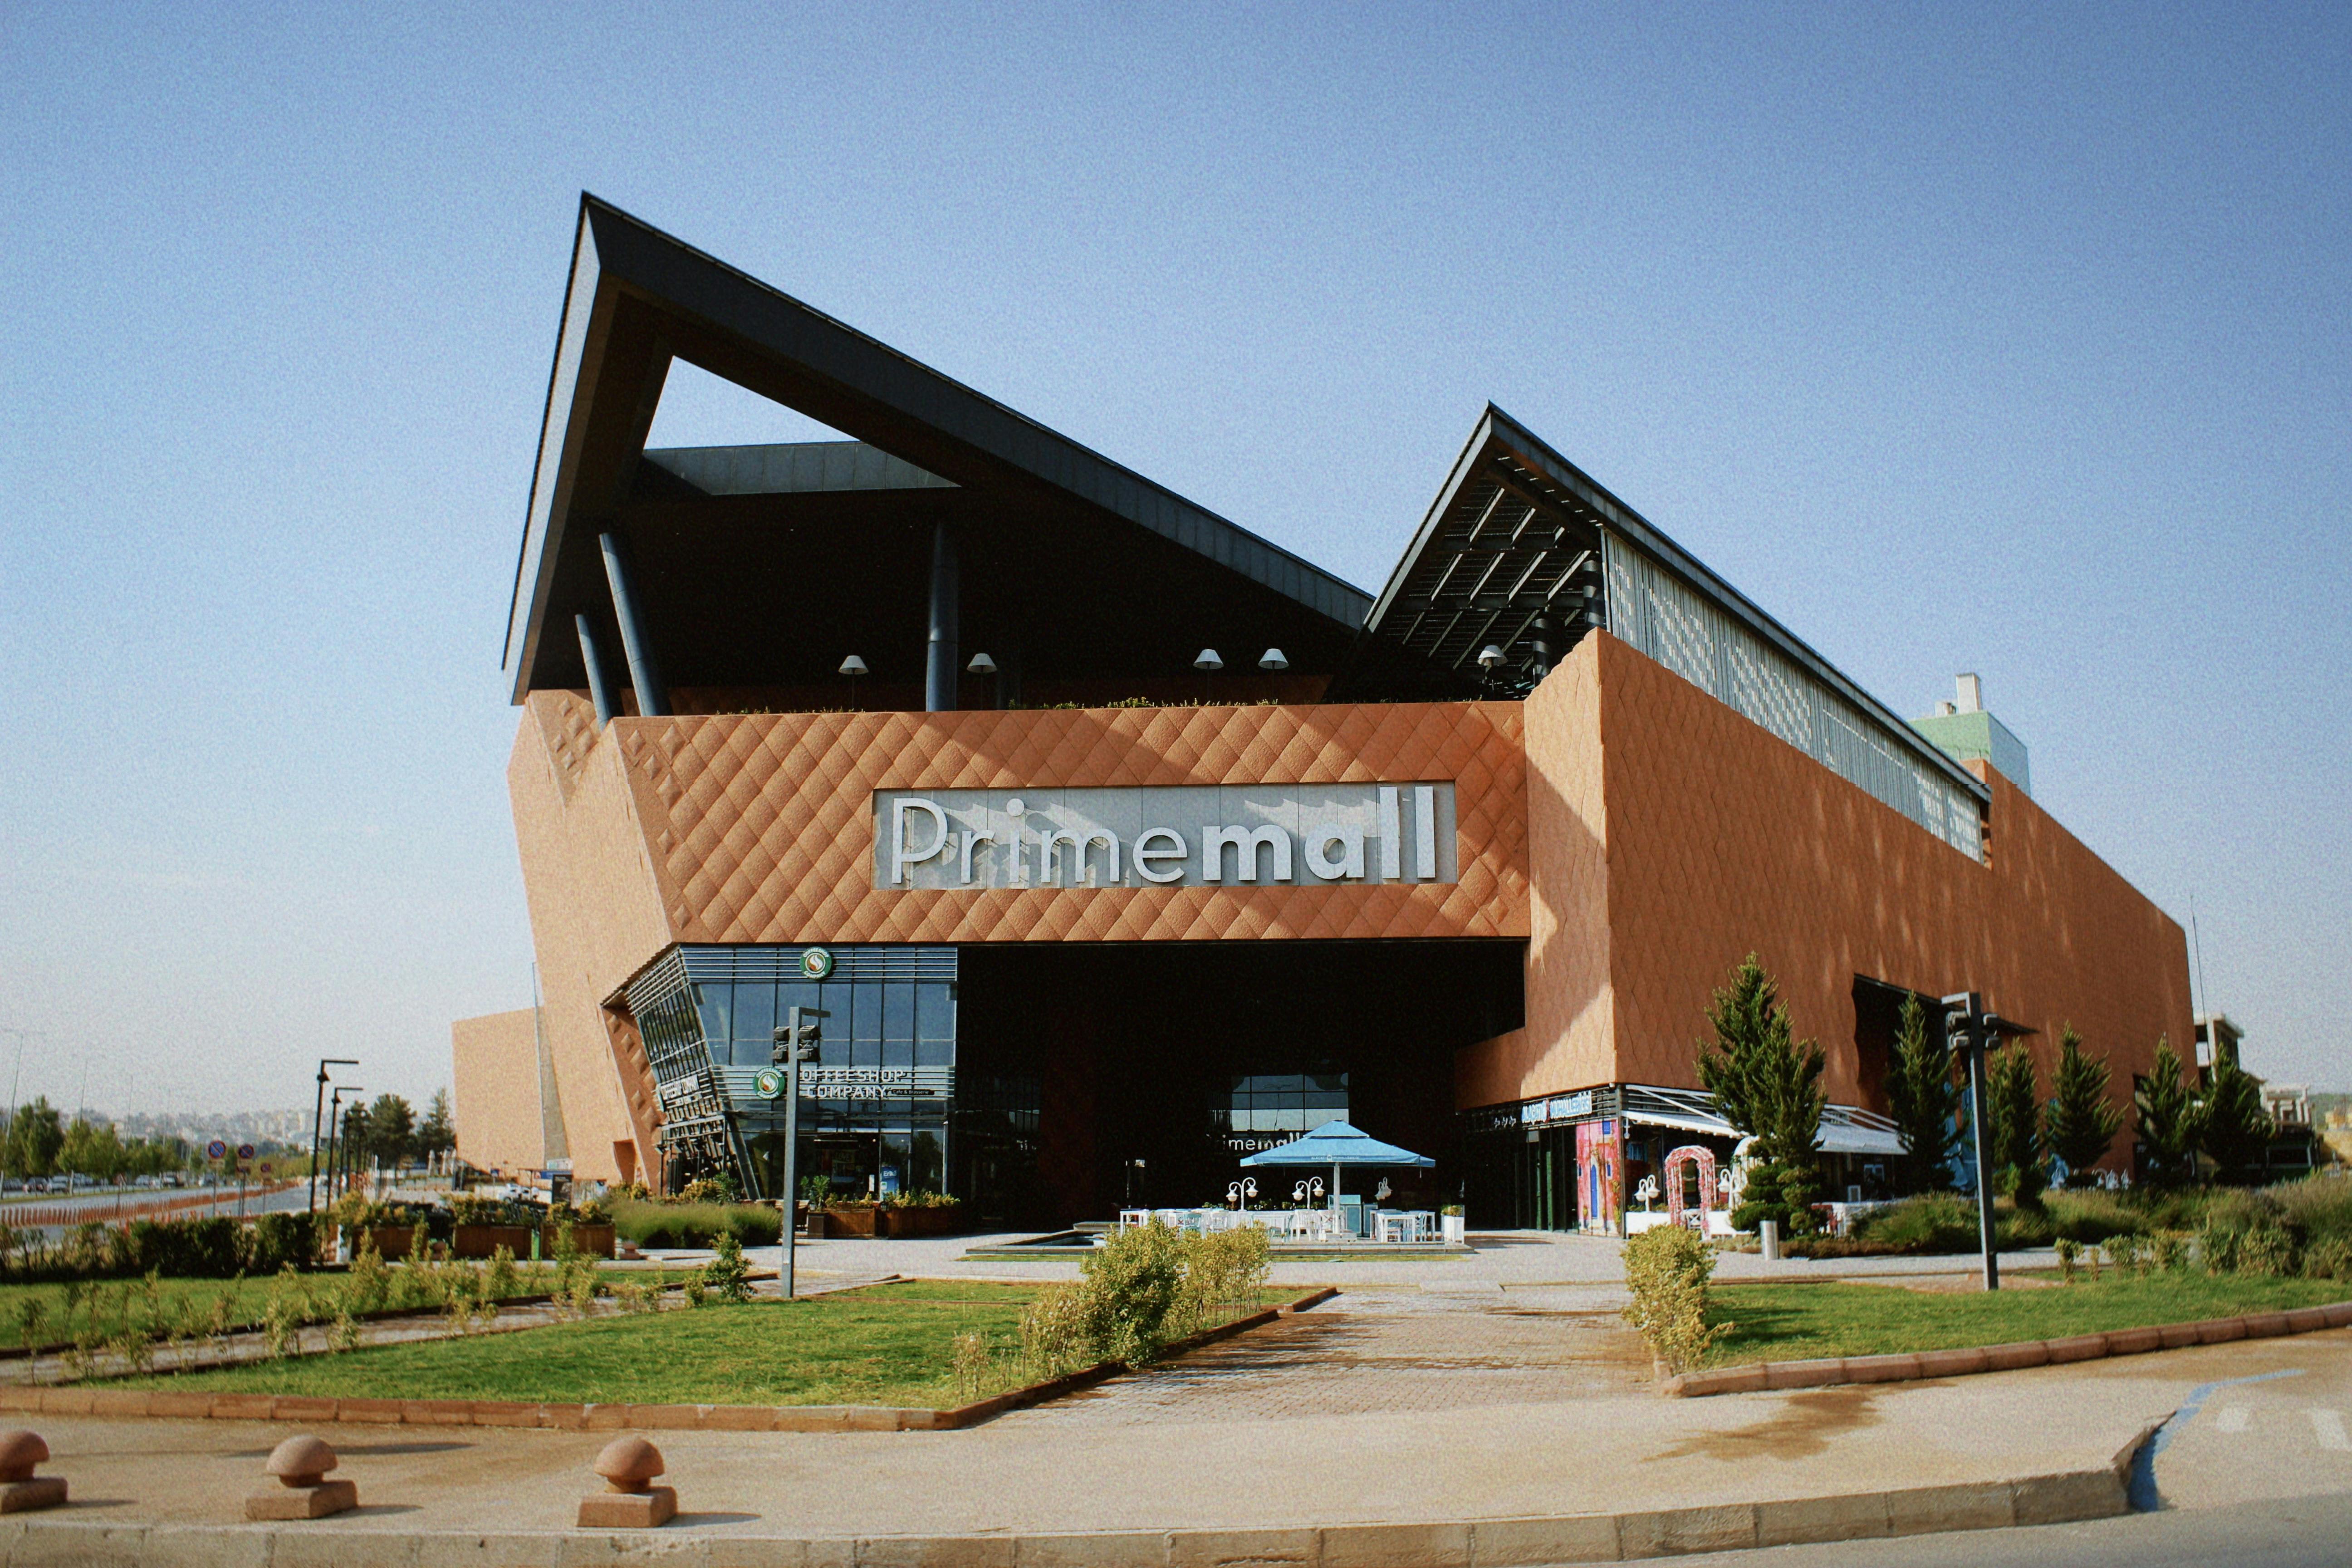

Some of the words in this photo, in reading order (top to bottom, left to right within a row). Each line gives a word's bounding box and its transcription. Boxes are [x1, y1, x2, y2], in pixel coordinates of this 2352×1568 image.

[892, 786, 1436, 884] Primemall
[802, 1069, 903, 1082] OFFEESHOP
[807, 1085, 888, 1098] COMPANY
